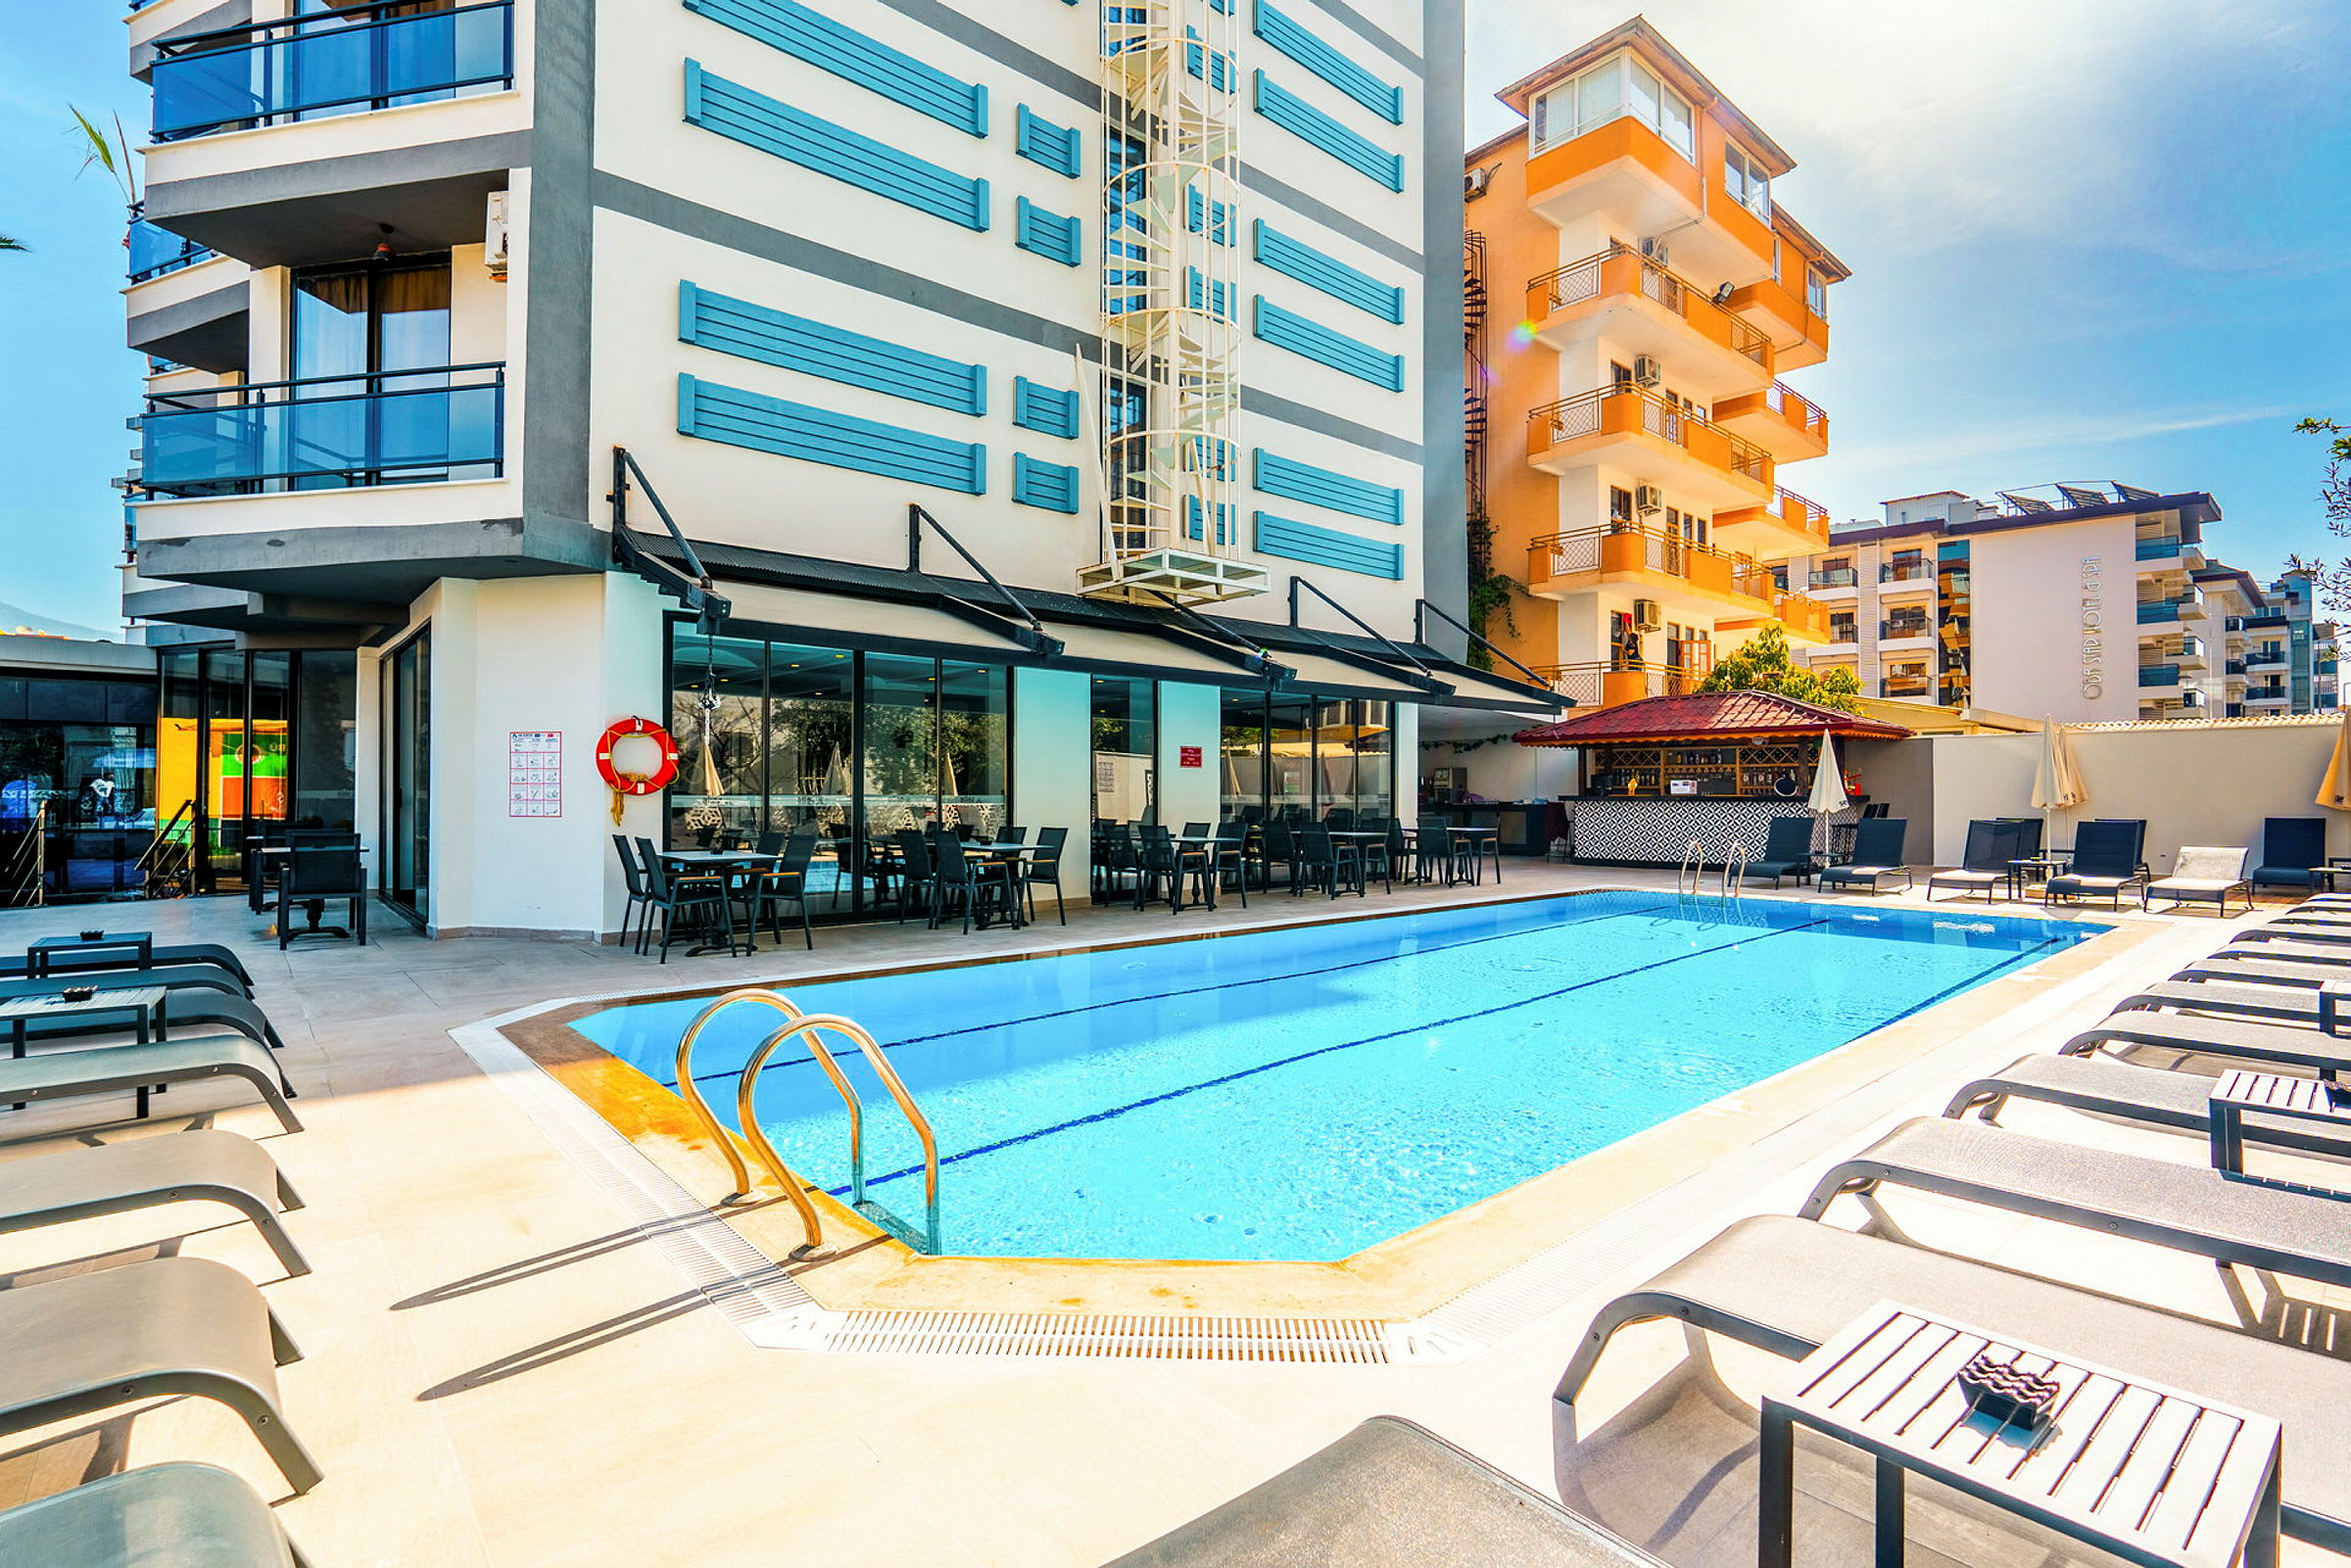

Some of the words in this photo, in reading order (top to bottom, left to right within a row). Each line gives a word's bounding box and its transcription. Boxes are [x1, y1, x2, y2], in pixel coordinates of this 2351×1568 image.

[2082, 555, 2102, 578] SPA
[2083, 595, 2102, 636] HOTEL
[2083, 669, 2102, 700] OBA
